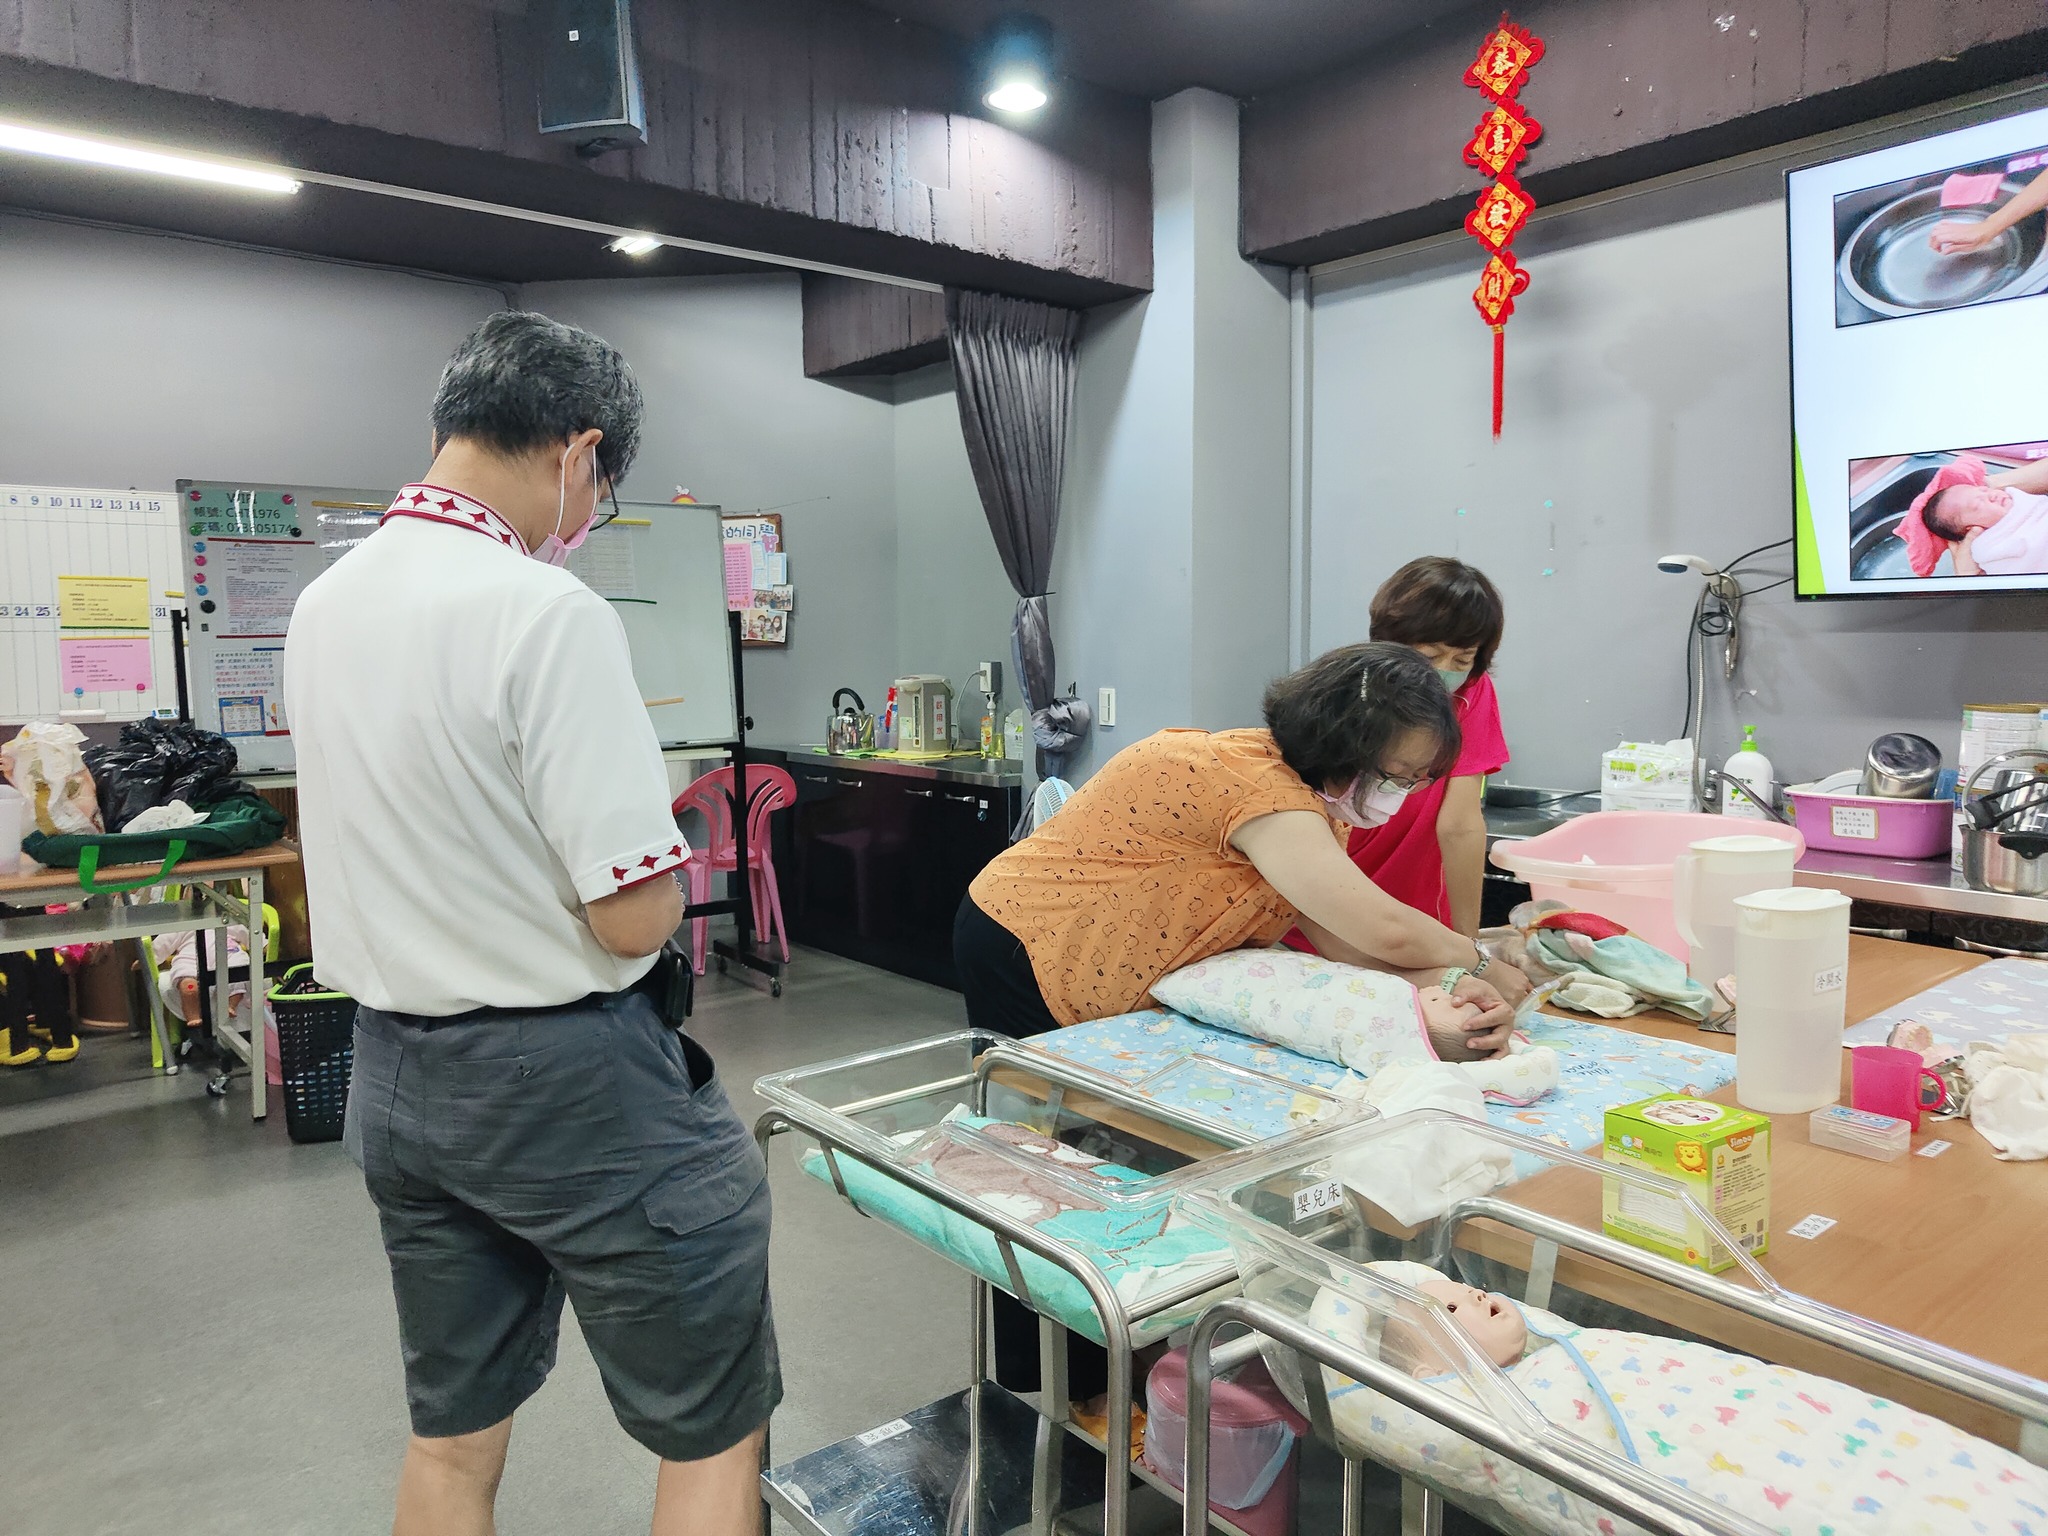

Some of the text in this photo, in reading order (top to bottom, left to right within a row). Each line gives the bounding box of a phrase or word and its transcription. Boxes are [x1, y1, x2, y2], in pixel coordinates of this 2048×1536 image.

[9, 494, 161, 512] 8 9 10 11 12 13 14 15
[14, 606, 29, 617] 24
[36, 606, 51, 617] 25
[155, 606, 167, 617] 31
[1296, 1182, 1341, 1215] 嬰兒床
